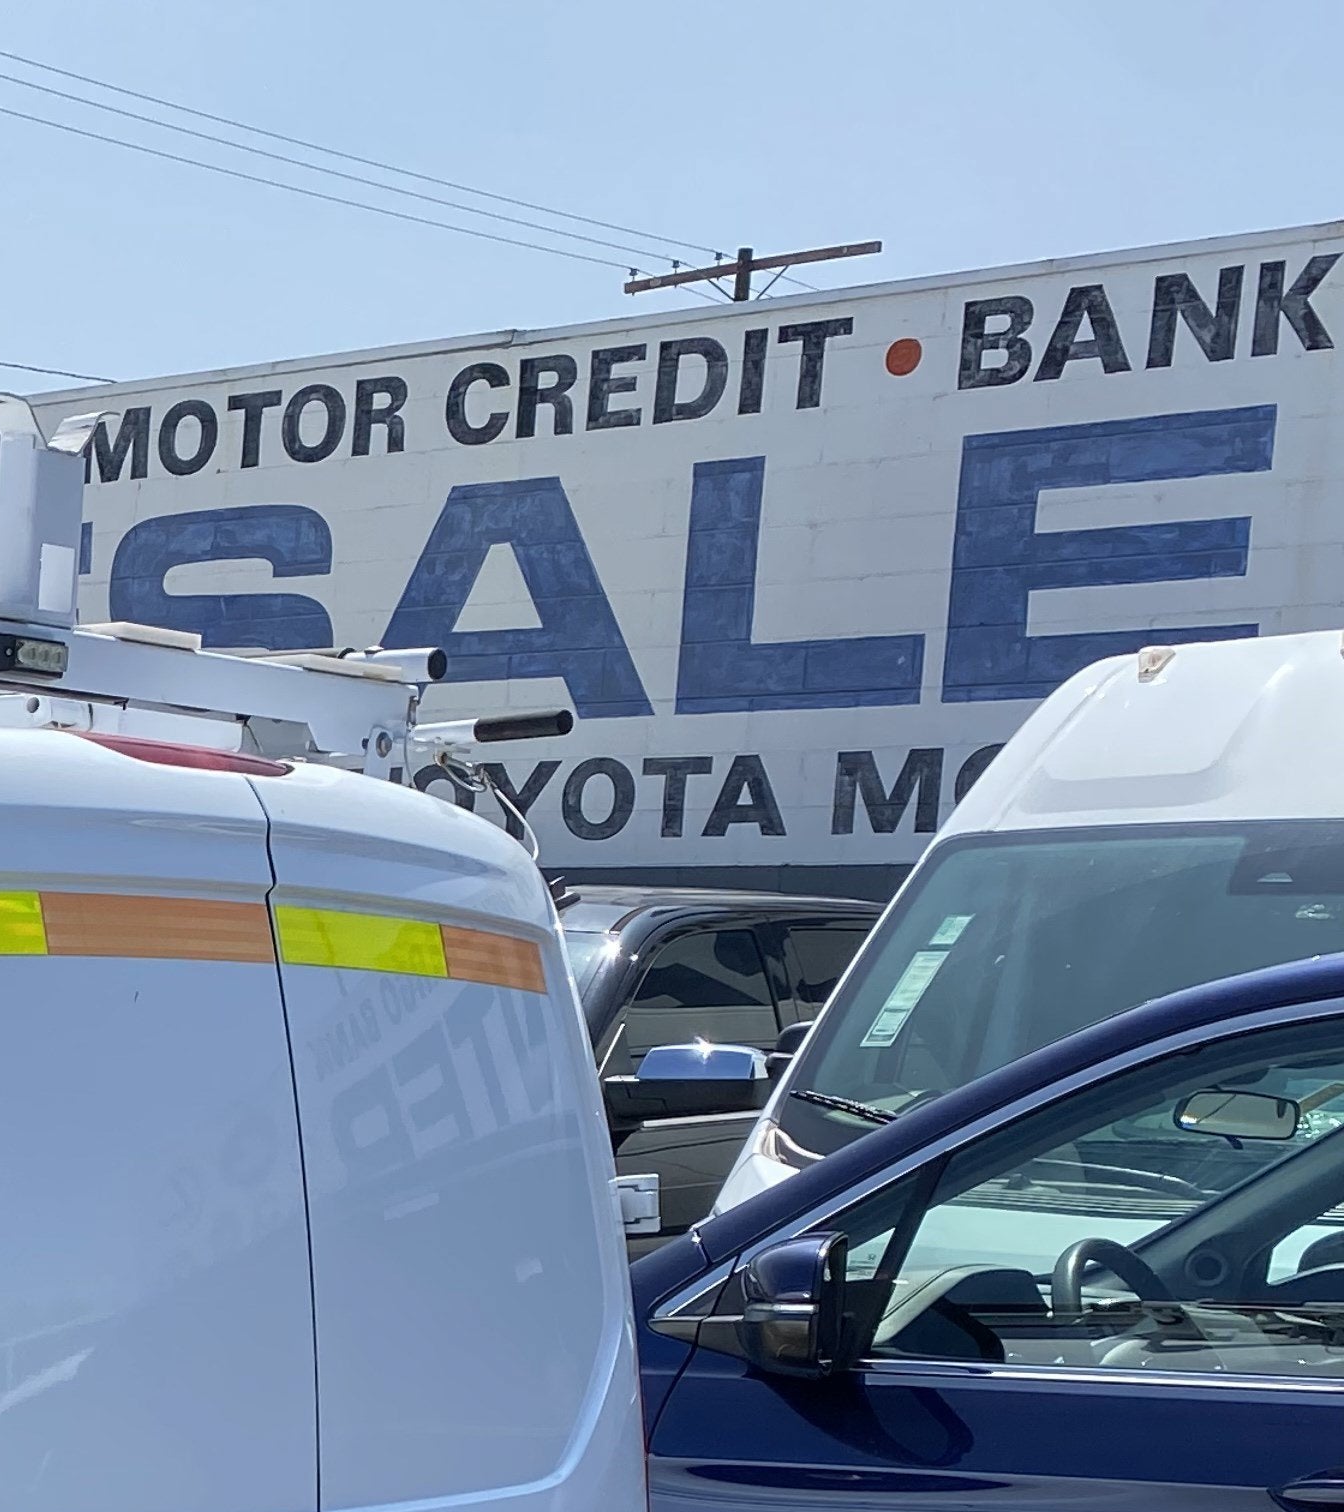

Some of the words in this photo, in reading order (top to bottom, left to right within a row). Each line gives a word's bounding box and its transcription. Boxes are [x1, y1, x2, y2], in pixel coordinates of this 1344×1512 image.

[84, 376, 408, 484] MOTOR
[445, 316, 854, 447] CREDIT
[959, 252, 1344, 391] BANK
